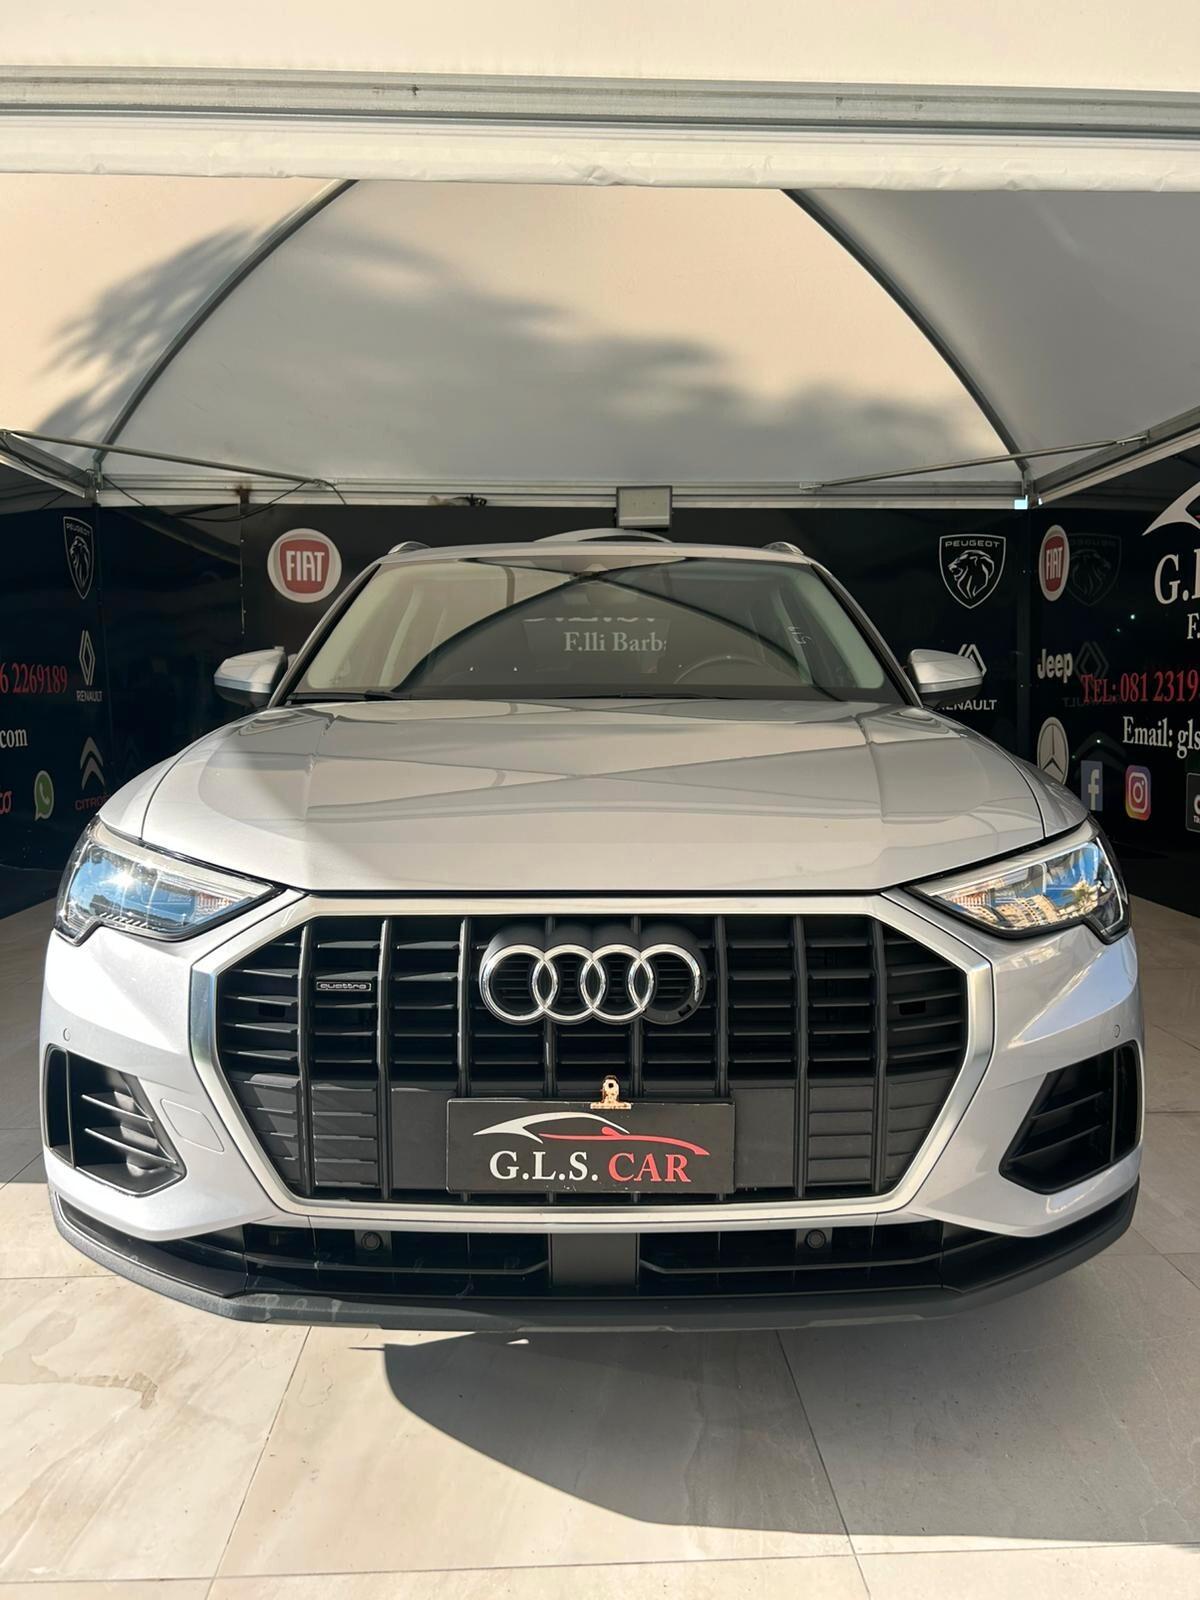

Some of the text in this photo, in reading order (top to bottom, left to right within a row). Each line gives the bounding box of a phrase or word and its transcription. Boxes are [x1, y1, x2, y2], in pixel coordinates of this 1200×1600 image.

[945, 540, 1000, 548] PEUGEOT
[286, 550, 325, 582] FIAT
[1046, 547, 1063, 579] FIAT
[564, 631, 667, 651] F.lli Barb
[12, 662, 68, 694] 2269189
[1037, 648, 1073, 684] Jeep
[1120, 671, 1148, 702] 081
[941, 699, 998, 711] NAULT
[1122, 716, 1173, 748] Email:
[320, 983, 367, 991] quattro
[489, 1150, 691, 1183] G.L.S. CAR
